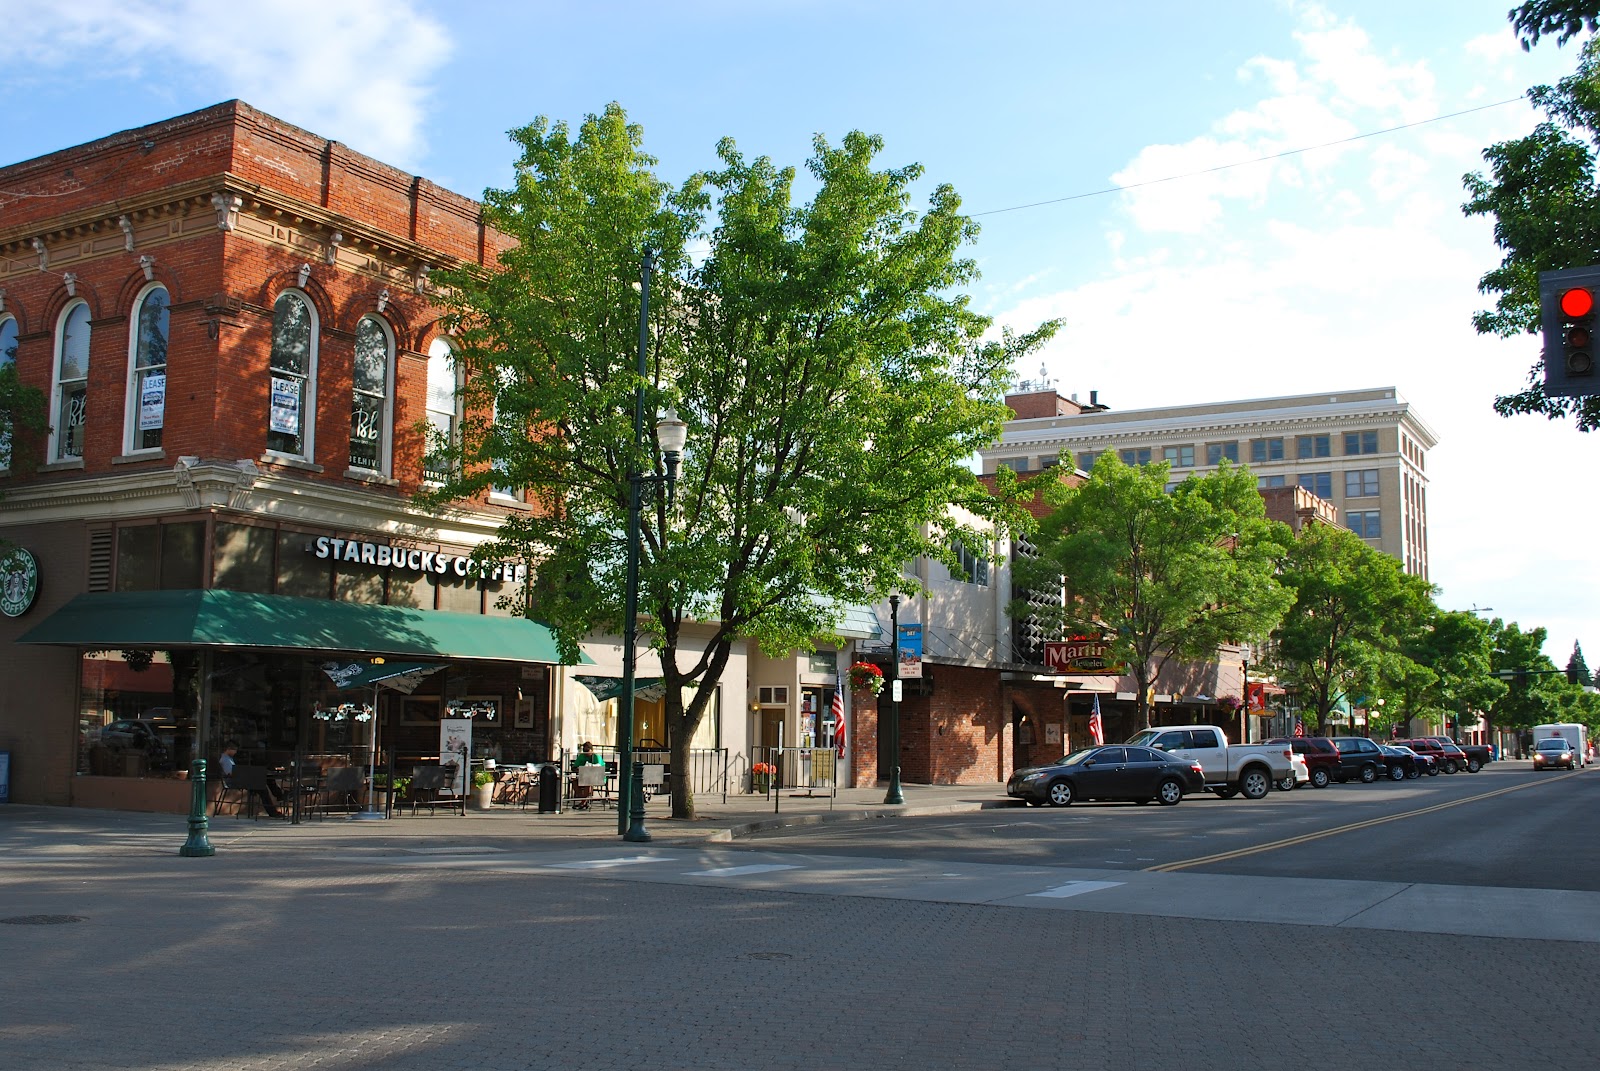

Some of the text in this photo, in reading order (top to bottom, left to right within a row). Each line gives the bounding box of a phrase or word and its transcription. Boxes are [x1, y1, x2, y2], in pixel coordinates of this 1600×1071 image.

[145, 378, 165, 390] LEASE
[275, 381, 299, 395] LEASE
[315, 536, 447, 574] STARBUCKS
[1, 597, 30, 614] COFFEE
